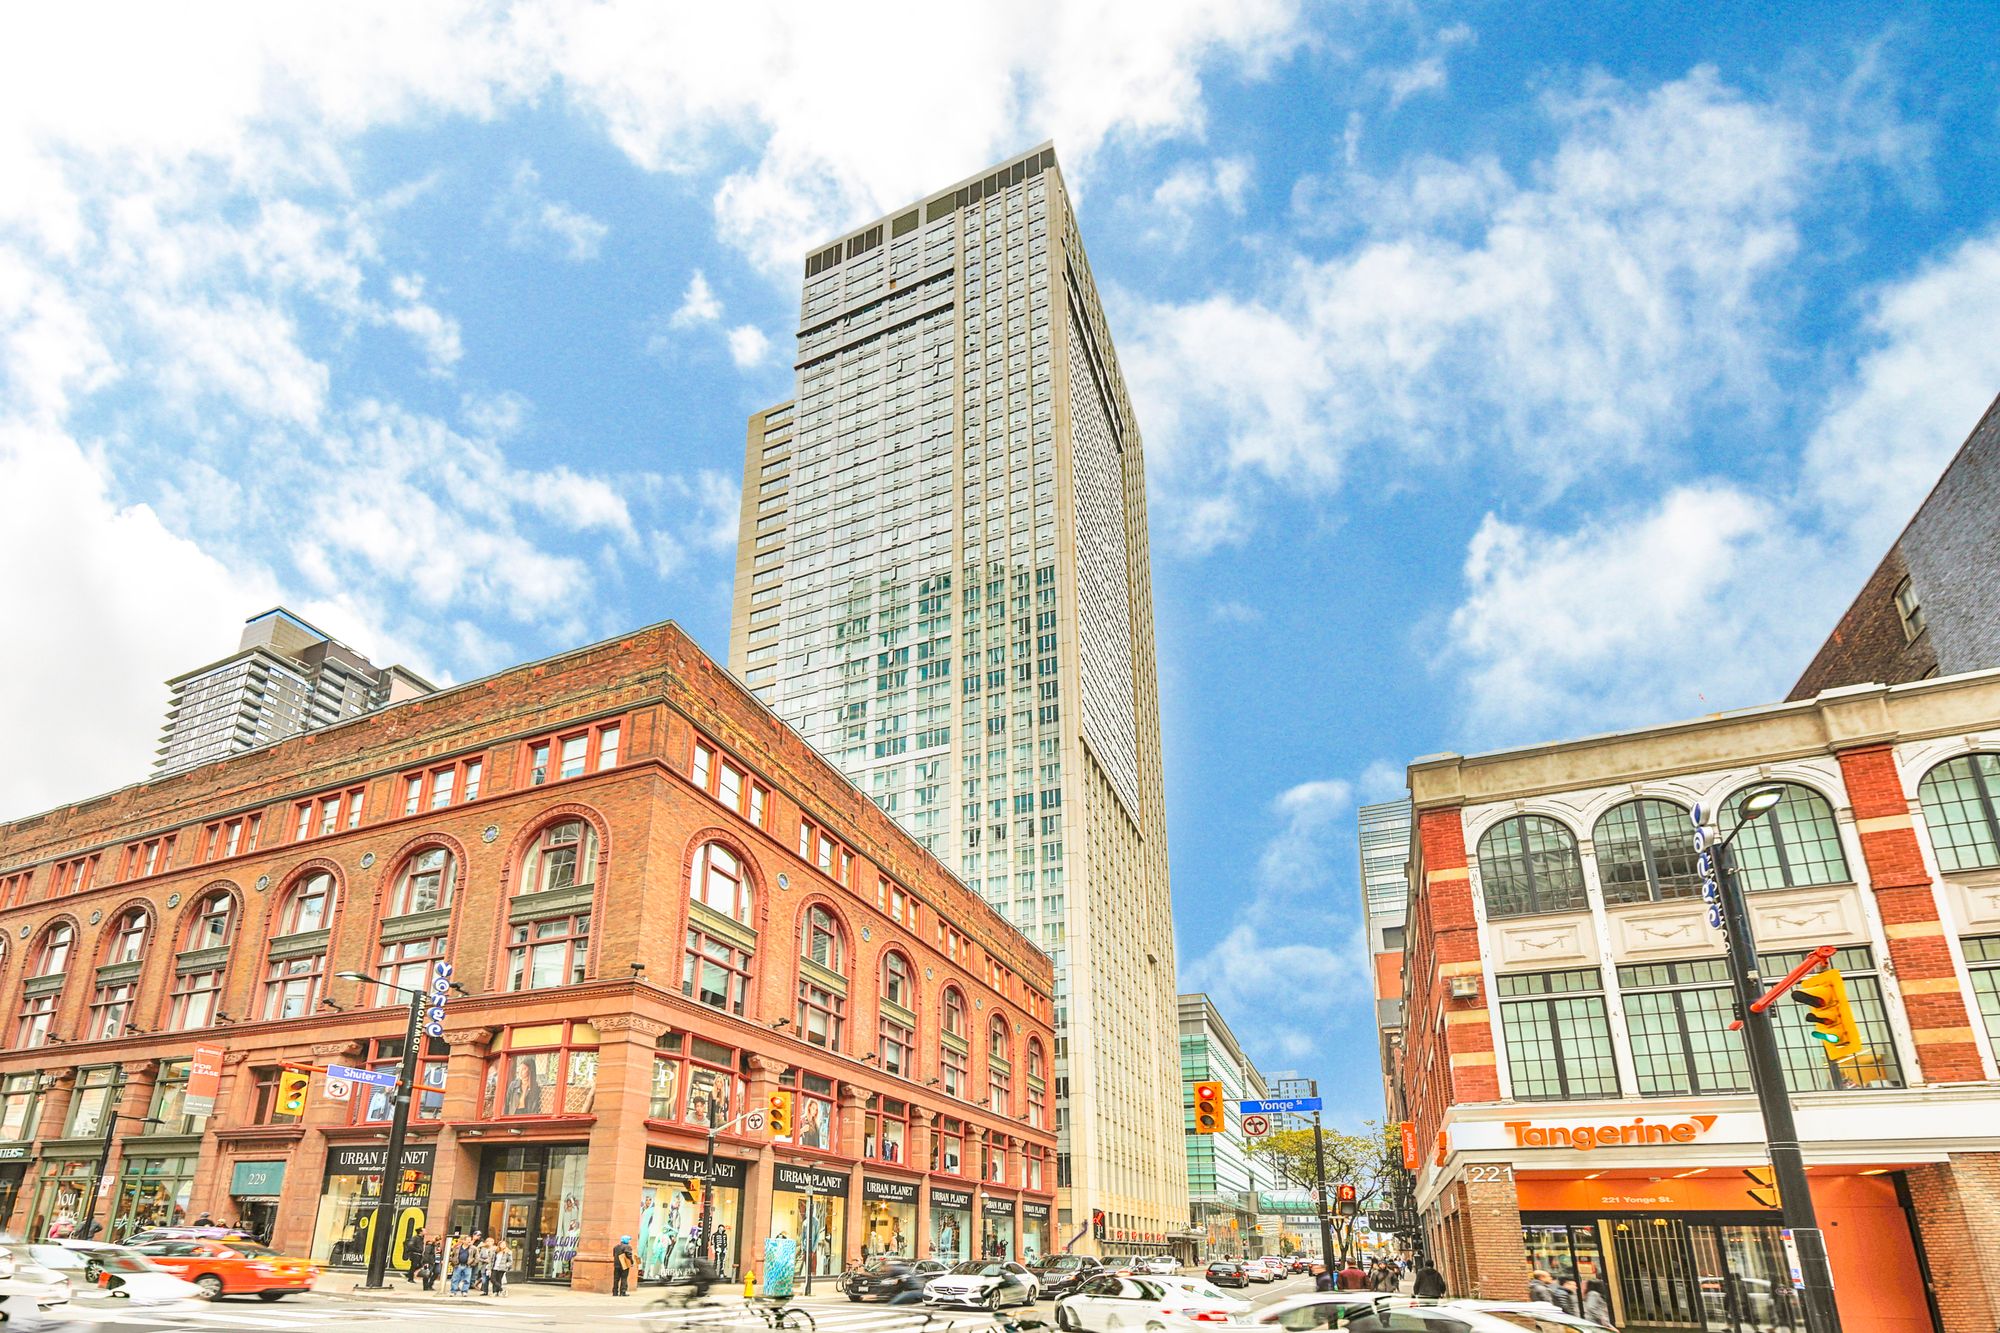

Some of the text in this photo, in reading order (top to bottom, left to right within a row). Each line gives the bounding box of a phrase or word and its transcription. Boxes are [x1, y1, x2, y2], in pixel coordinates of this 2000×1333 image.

[412, 995, 427, 1051] DOWNTOWN
[193, 1069, 219, 1077] LEASE
[344, 1068, 375, 1081] Shuter
[1259, 1101, 1294, 1111] Yonge
[1504, 1117, 1697, 1151] Tangerine
[340, 1151, 428, 1165] URBAN PNET
[648, 1154, 690, 1171] URBAN
[247, 1173, 267, 1185] 229
[780, 1169, 842, 1189] URBAN PLANET
[1470, 1167, 1514, 1183] 221
[867, 1181, 913, 1197] URBAN PLANET
[400, 1198, 422, 1206] MATCH
[932, 1191, 968, 1205] URBAN PLANET
[1624, 1197, 1655, 1205] Yonge
[342, 1253, 364, 1262] URBAN
